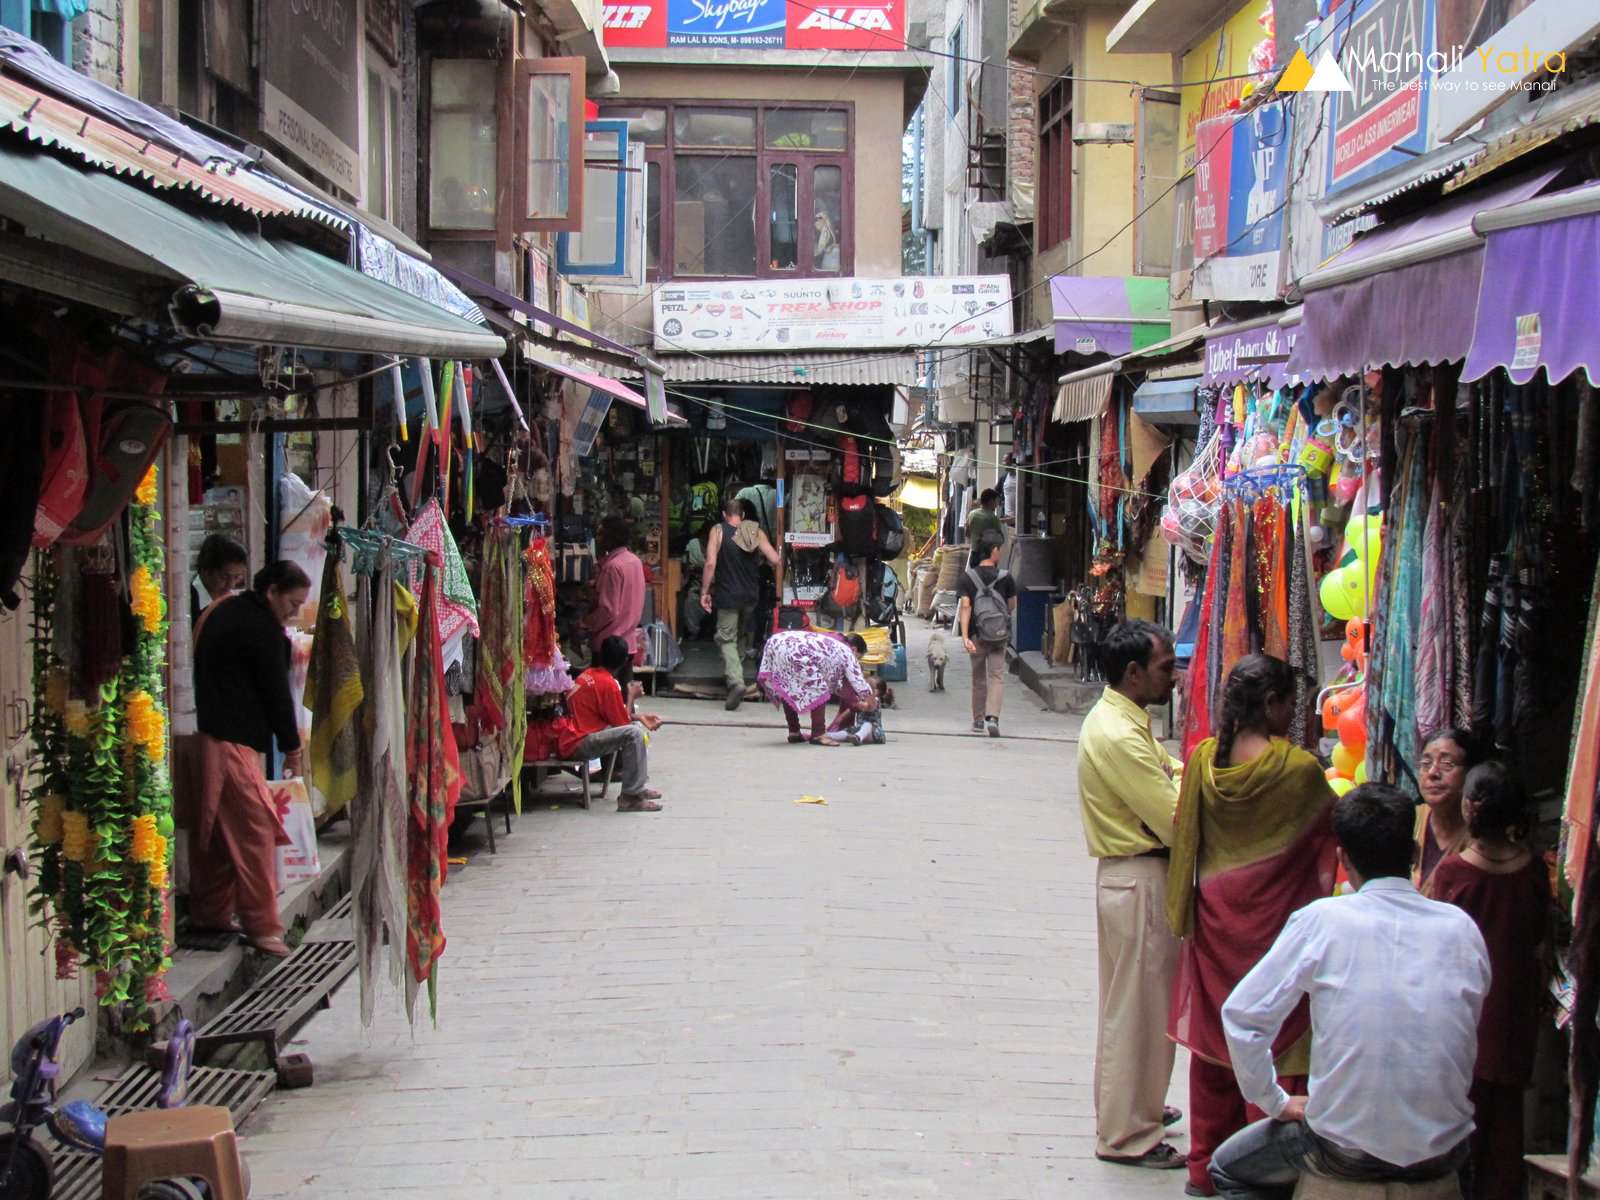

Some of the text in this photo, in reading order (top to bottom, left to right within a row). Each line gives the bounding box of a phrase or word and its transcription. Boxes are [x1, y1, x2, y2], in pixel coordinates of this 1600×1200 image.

[798, 7, 893, 30] ALFA
[670, 36, 687, 45] RAM
[687, 36, 701, 45] LAL
[701, 36, 708, 45] &
[708, 36, 731, 46] SONS,
[1339, 0, 1418, 121] NEVA
[279, 109, 311, 151] PERSONAL
[1336, 97, 1416, 165] WORLD CLASS INNERWEAR
[784, 290, 822, 299] SUUNTO
[662, 304, 688, 314] PETZL
[767, 300, 883, 313] TREK SHOP
